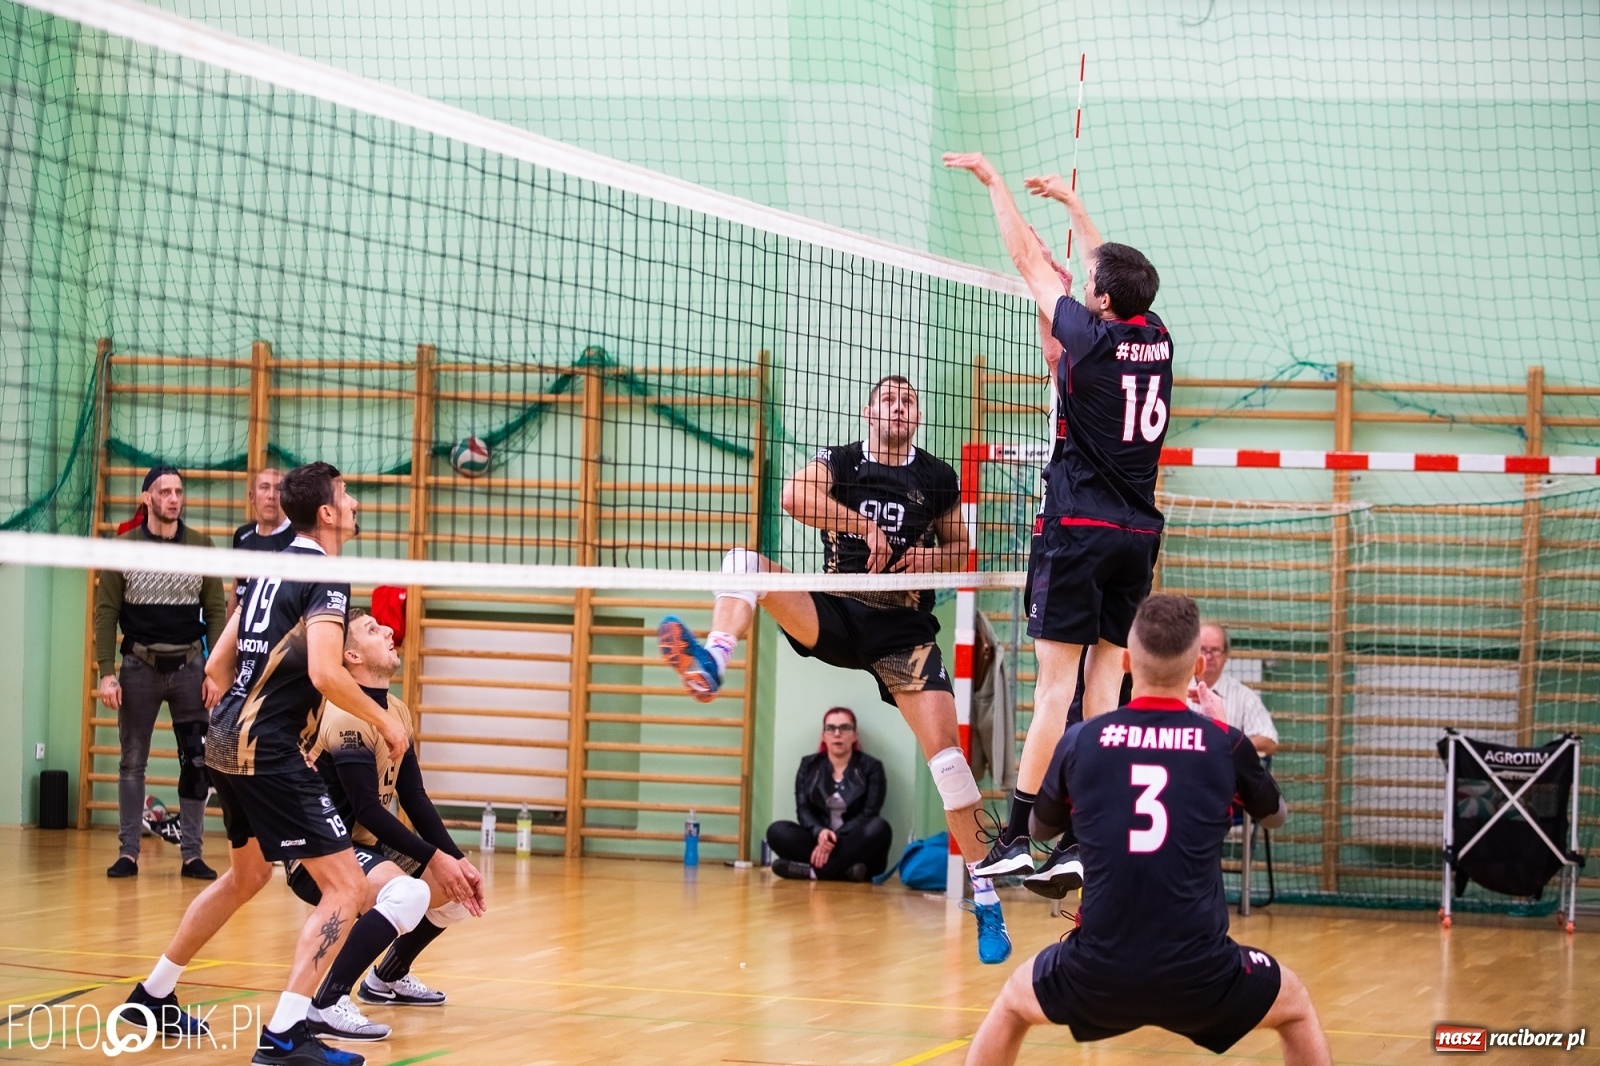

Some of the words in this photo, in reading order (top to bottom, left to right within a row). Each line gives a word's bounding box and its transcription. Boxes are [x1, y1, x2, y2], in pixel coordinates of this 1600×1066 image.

[1121, 374, 1168, 442] 16
[859, 499, 905, 532] 99
[245, 576, 282, 633] 19
[1099, 724, 1206, 752] #DANIEL
[1484, 750, 1549, 765] AGROTIM
[1128, 763, 1170, 853] 3
[326, 814, 347, 838] 19
